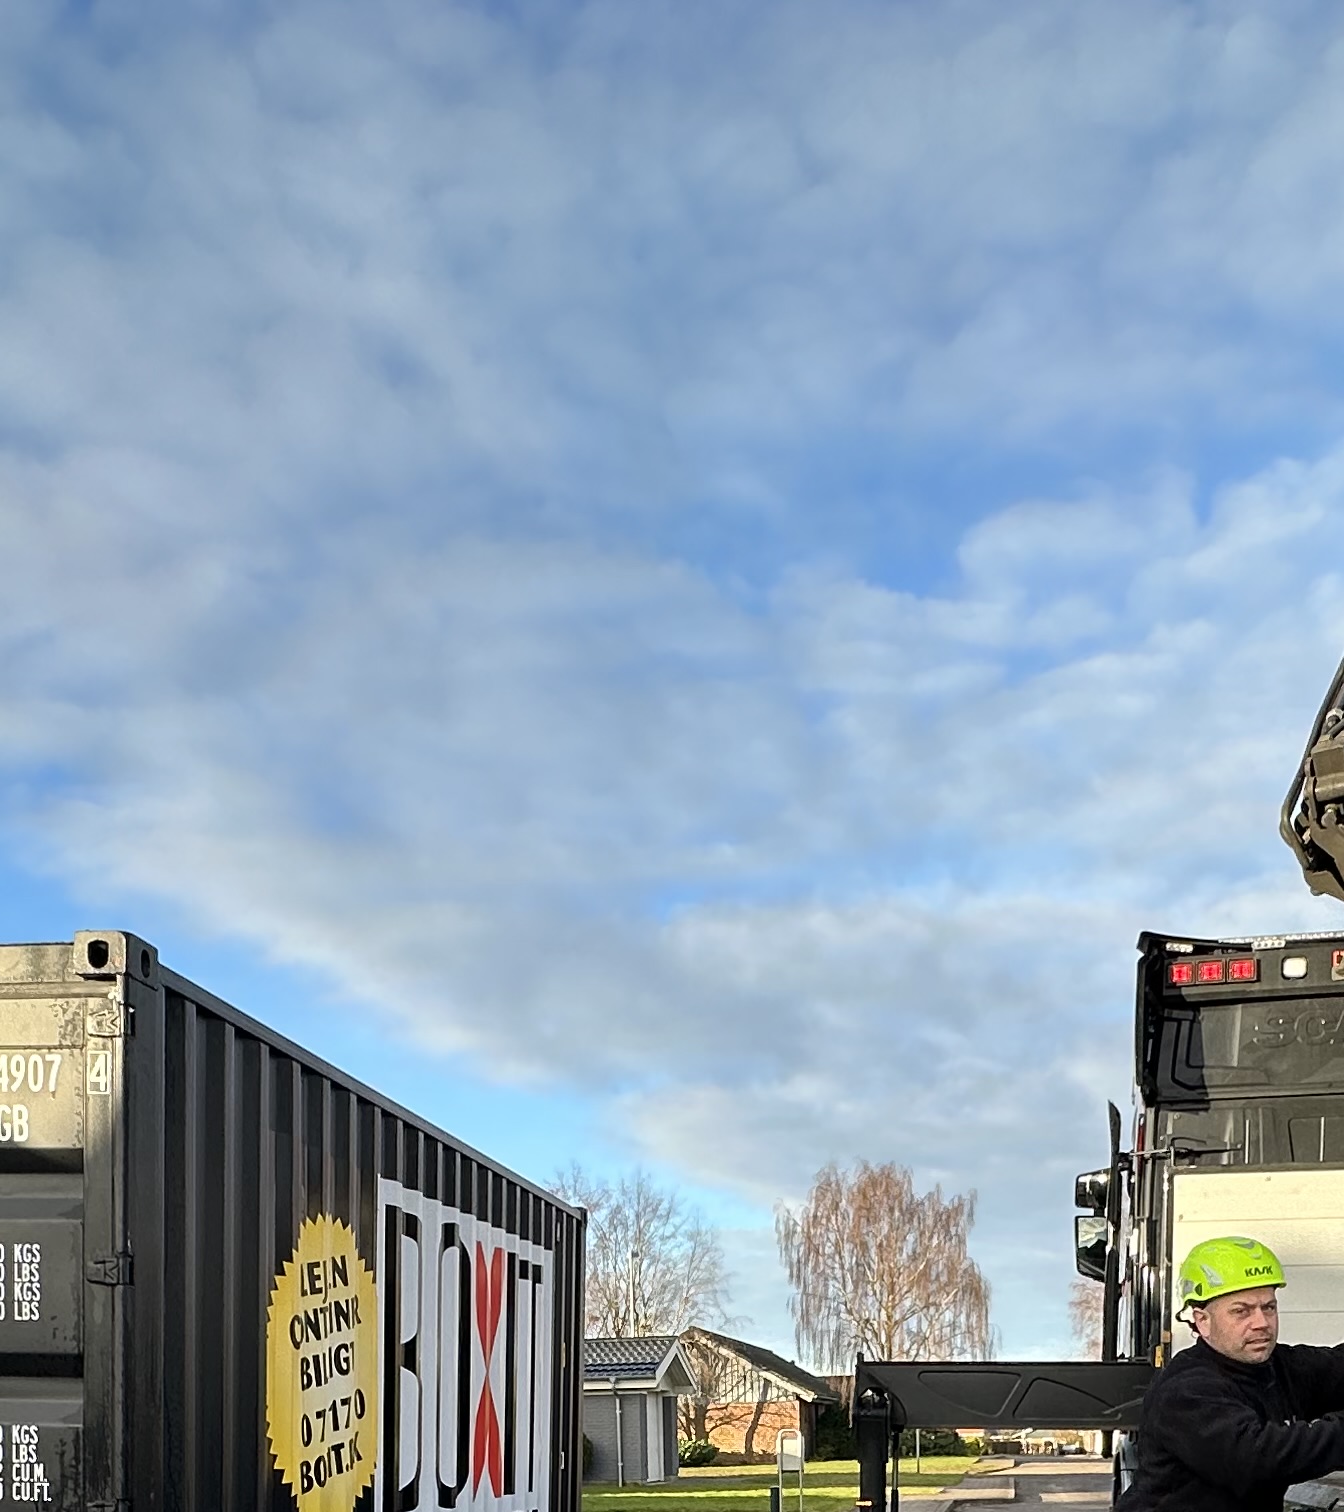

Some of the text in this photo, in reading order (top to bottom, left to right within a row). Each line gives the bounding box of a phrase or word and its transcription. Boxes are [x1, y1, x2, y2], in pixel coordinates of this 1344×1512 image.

[89, 1054, 107, 1091] 4
[13, 1243, 41, 1263] KGS
[13, 1263, 40, 1282] LBS
[1244, 1265, 1274, 1278] KASK
[13, 1283, 41, 1302] KGS
[13, 1302, 40, 1321] LBS
[11, 1424, 38, 1444] KGS
[11, 1444, 37, 1463] LBS
